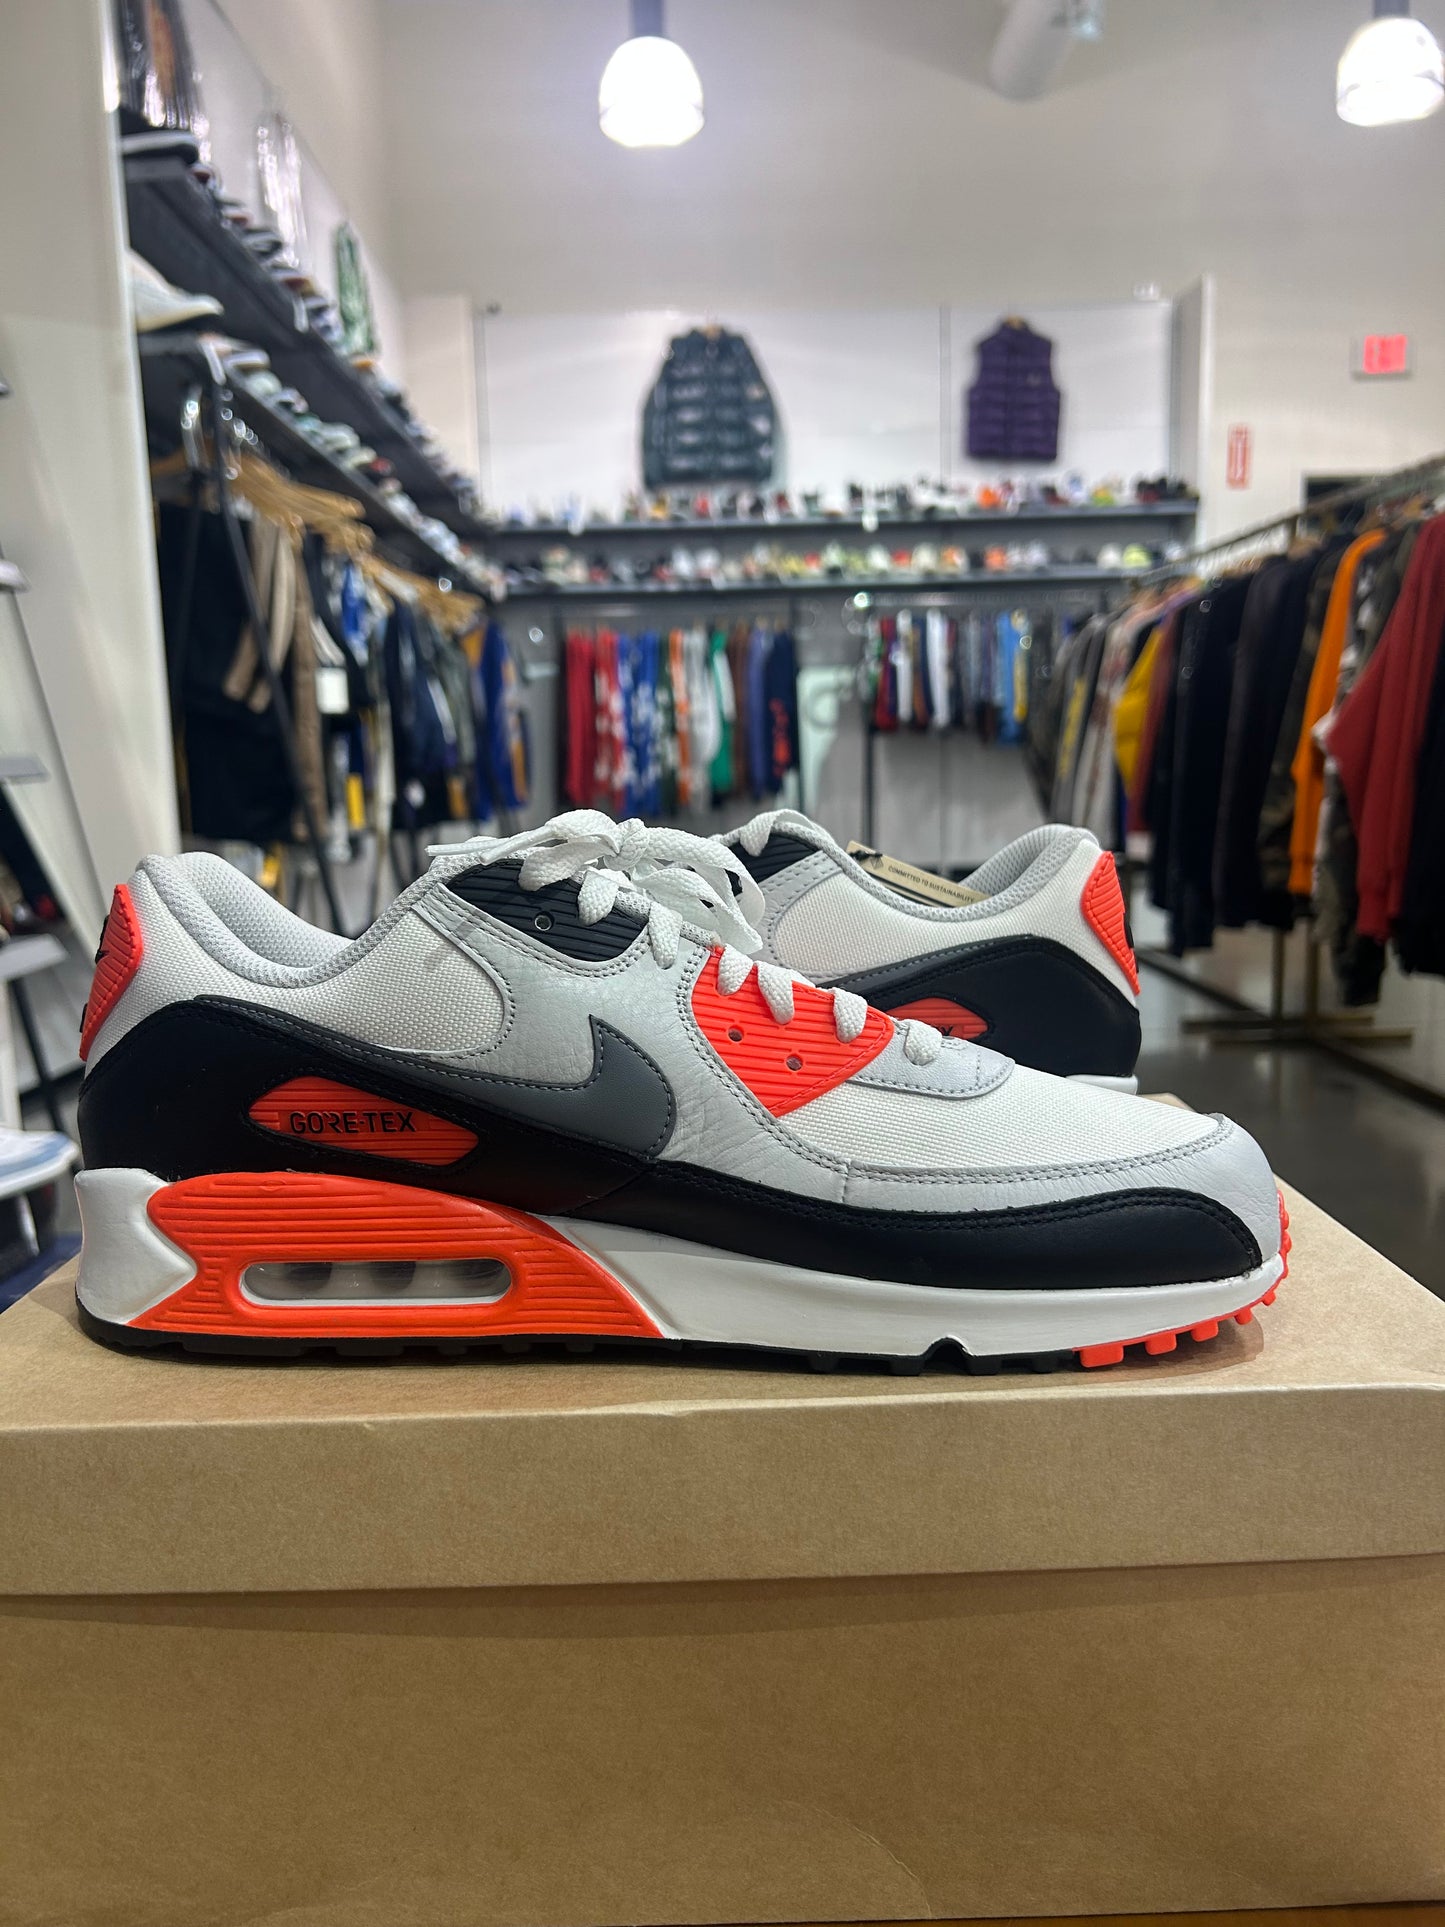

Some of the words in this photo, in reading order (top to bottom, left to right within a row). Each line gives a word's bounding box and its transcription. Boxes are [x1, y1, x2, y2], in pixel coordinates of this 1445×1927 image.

[888, 865, 921, 882] COMMITTED
[921, 878, 929, 887] TO
[929, 881, 976, 902] SUSTAINABILITY
[289, 1111, 417, 1134] GORE-TEX
